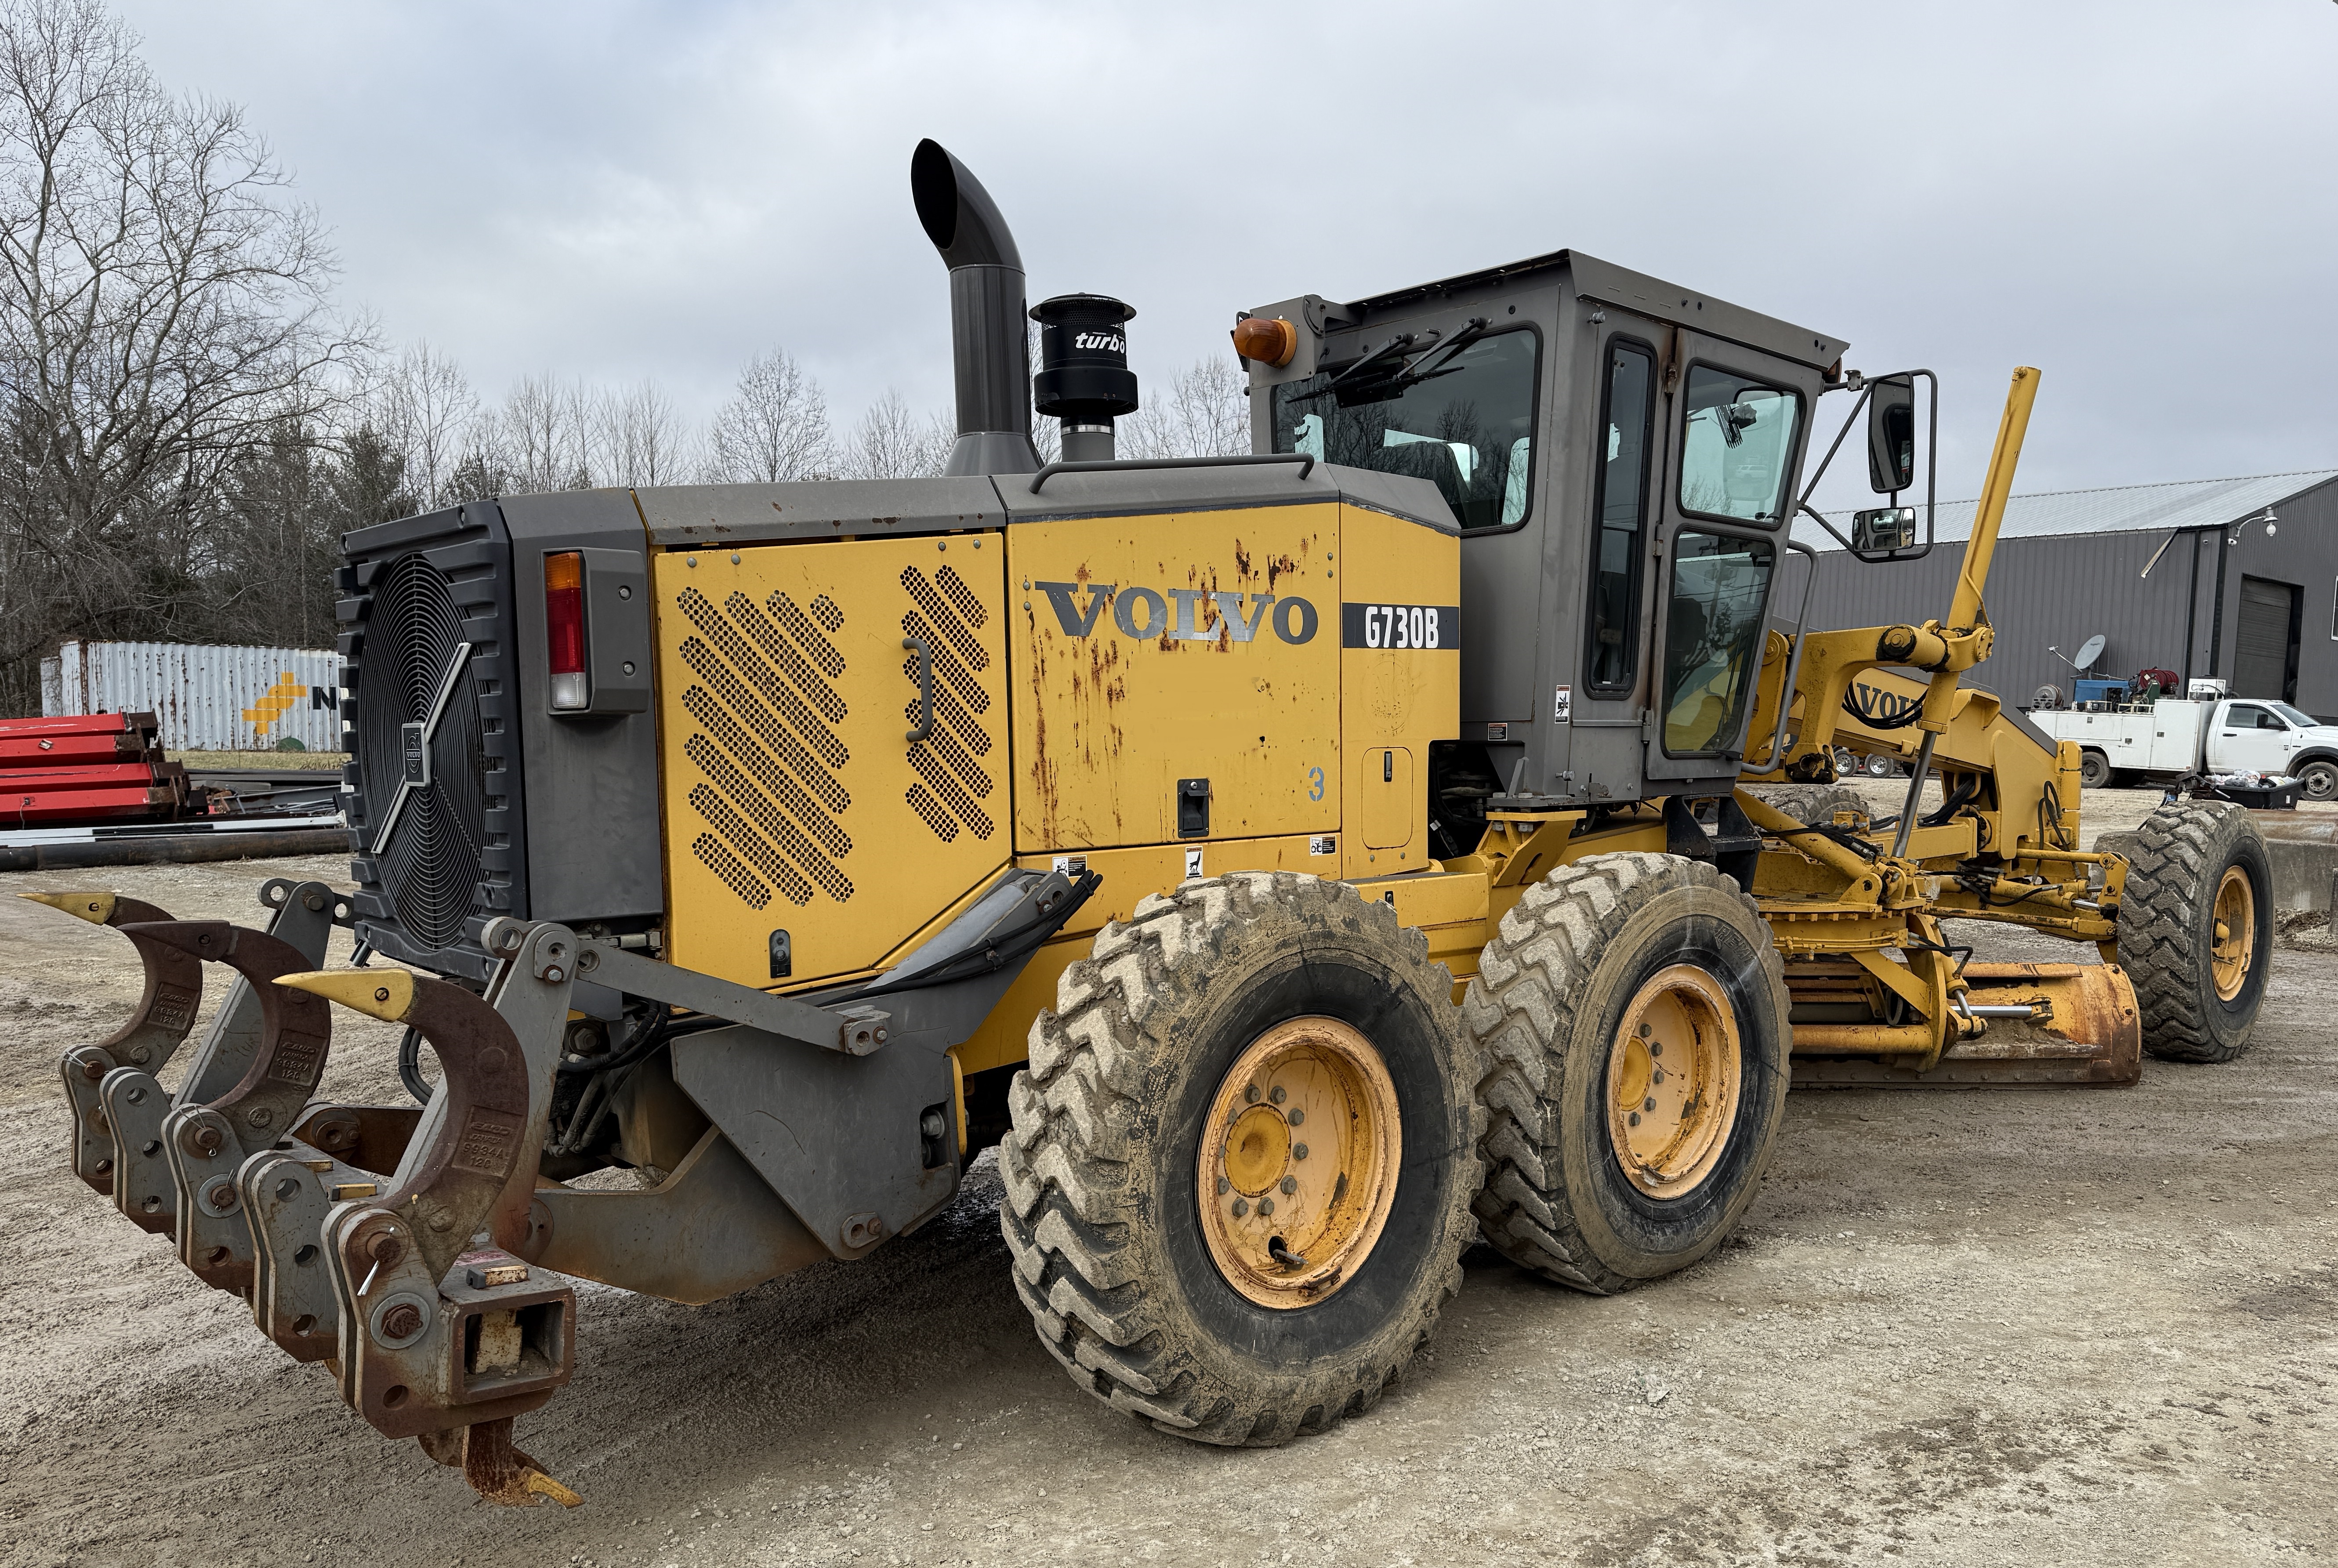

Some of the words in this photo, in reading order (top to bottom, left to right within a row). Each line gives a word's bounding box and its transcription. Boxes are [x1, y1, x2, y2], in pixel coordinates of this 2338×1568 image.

[1075, 332, 1125, 354] turbo
[1034, 581, 1319, 645] VOLVO
[1365, 605, 1439, 648] G730B
[312, 686, 337, 710] N
[1309, 766, 1324, 802] 3
